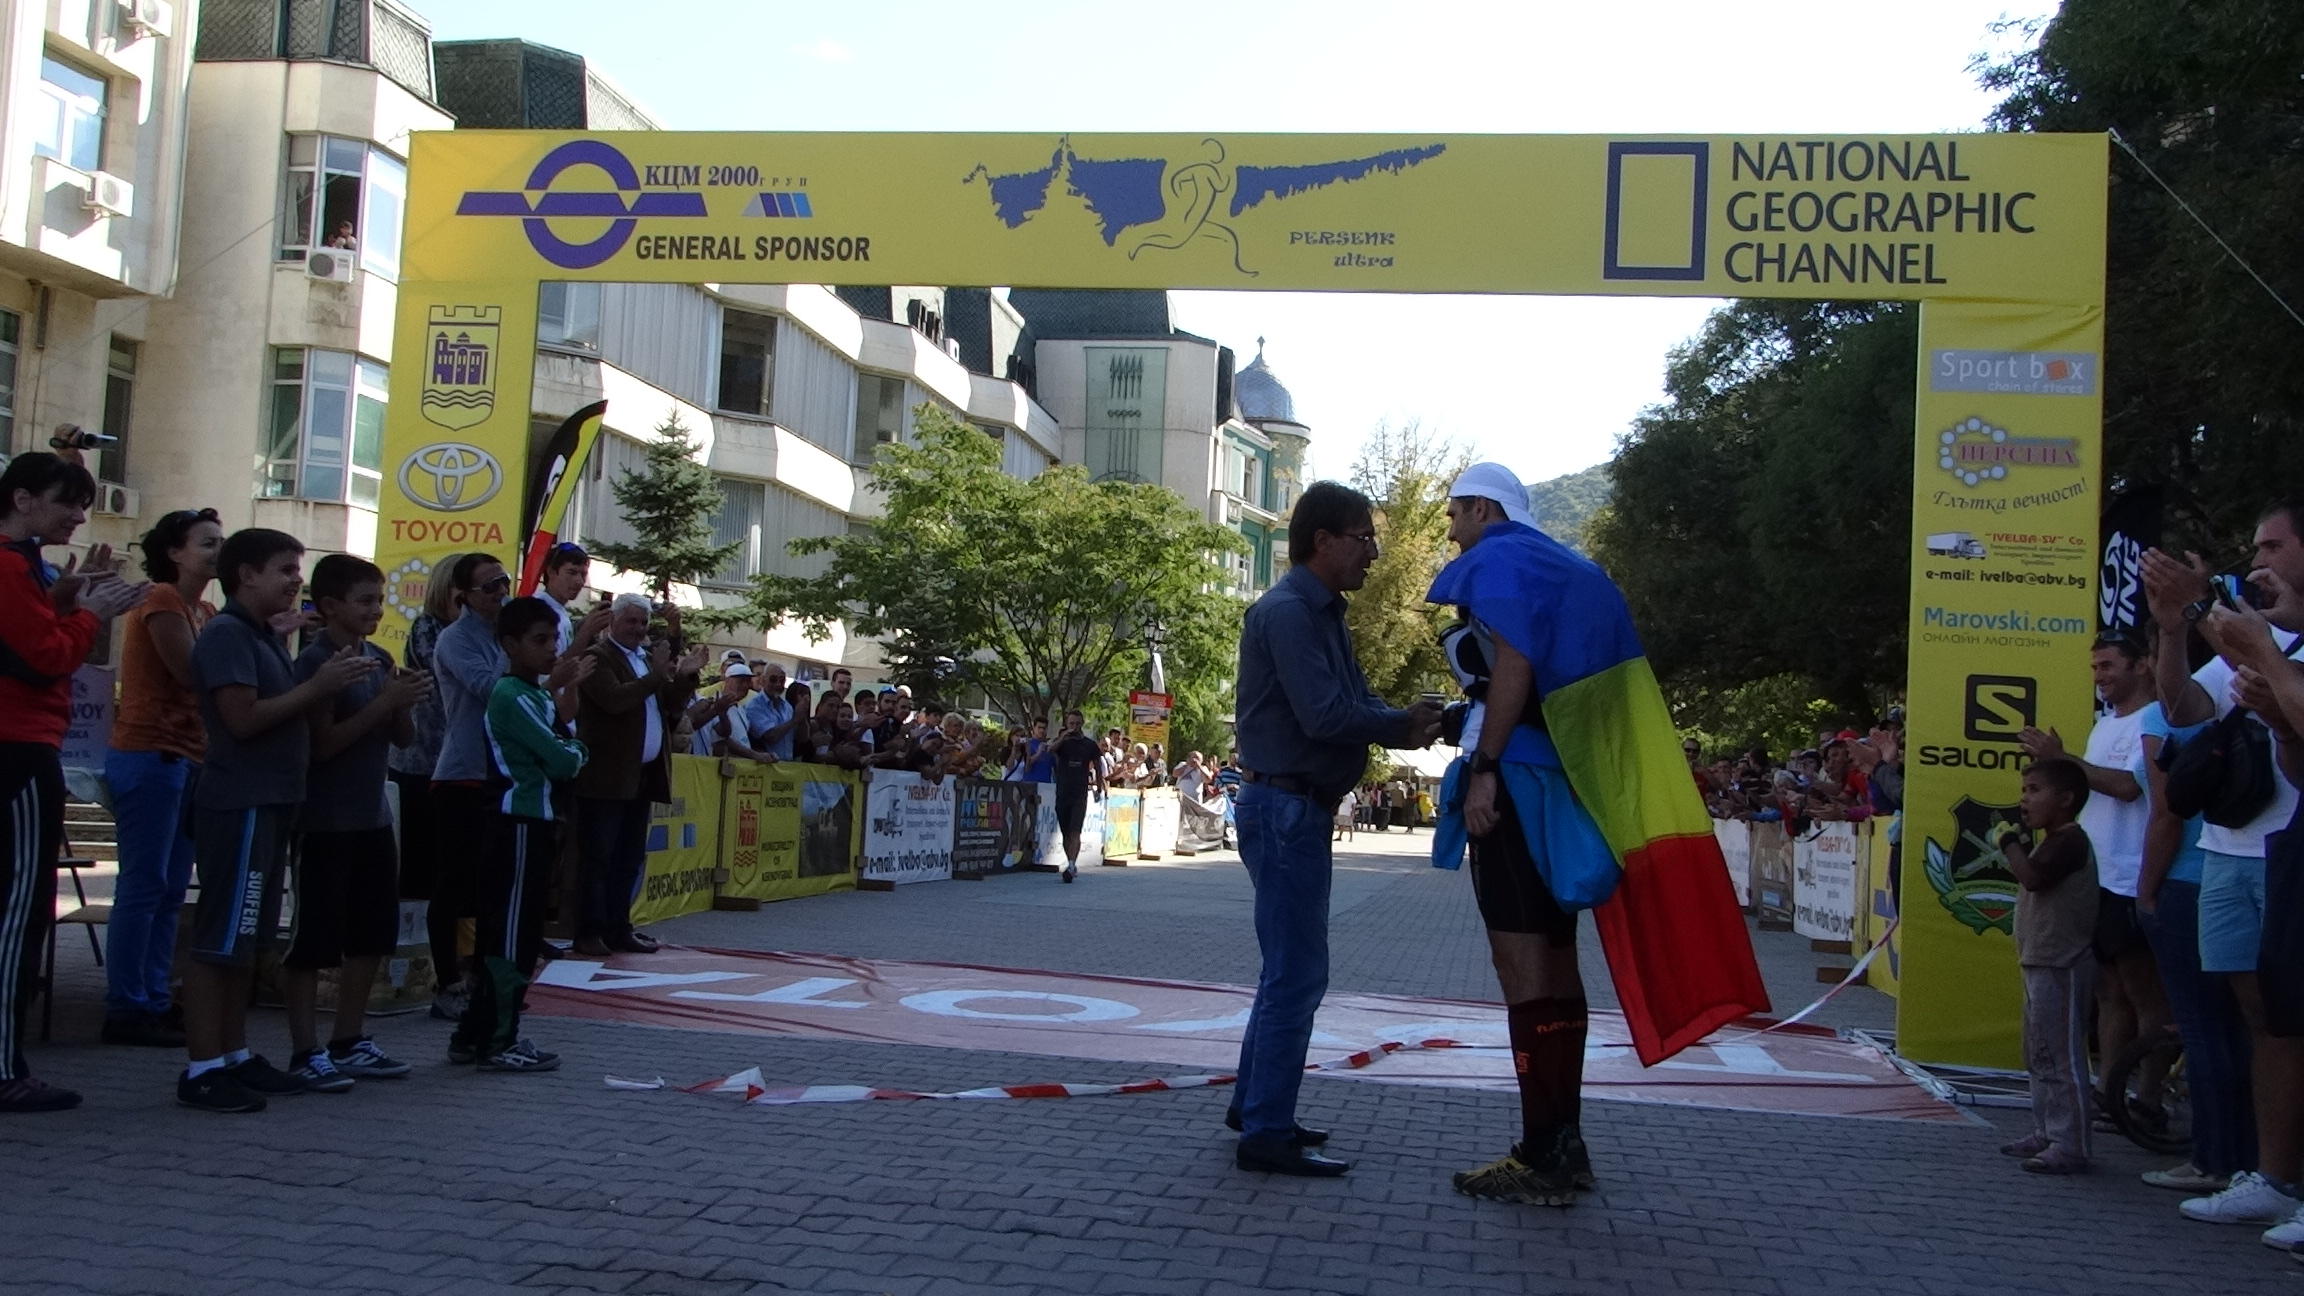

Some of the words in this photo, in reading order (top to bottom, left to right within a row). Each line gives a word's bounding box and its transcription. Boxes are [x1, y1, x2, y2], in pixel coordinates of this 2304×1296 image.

[1731, 140, 1970, 183] NATIONAL
[644, 165, 702, 191] КЦМ
[707, 166, 759, 187] 2000
[1725, 190, 2036, 234] GEOGRAPHIC
[635, 235, 746, 261] GENERAL
[754, 236, 870, 262] SPONSOR
[1333, 252, 1395, 268] ultra
[1723, 241, 1947, 285] CHANNEL
[1941, 352, 2018, 382] Sport
[1933, 489, 2007, 515] Глътка
[2013, 477, 2088, 509] вечност!
[391, 519, 504, 544] TOYOTA
[1926, 569, 1974, 582] e-mail:
[1980, 571, 2086, 589] ivelba@abv.bg
[1924, 606, 2085, 635] Marovski.com
[239, 870, 264, 935] SURFERS
